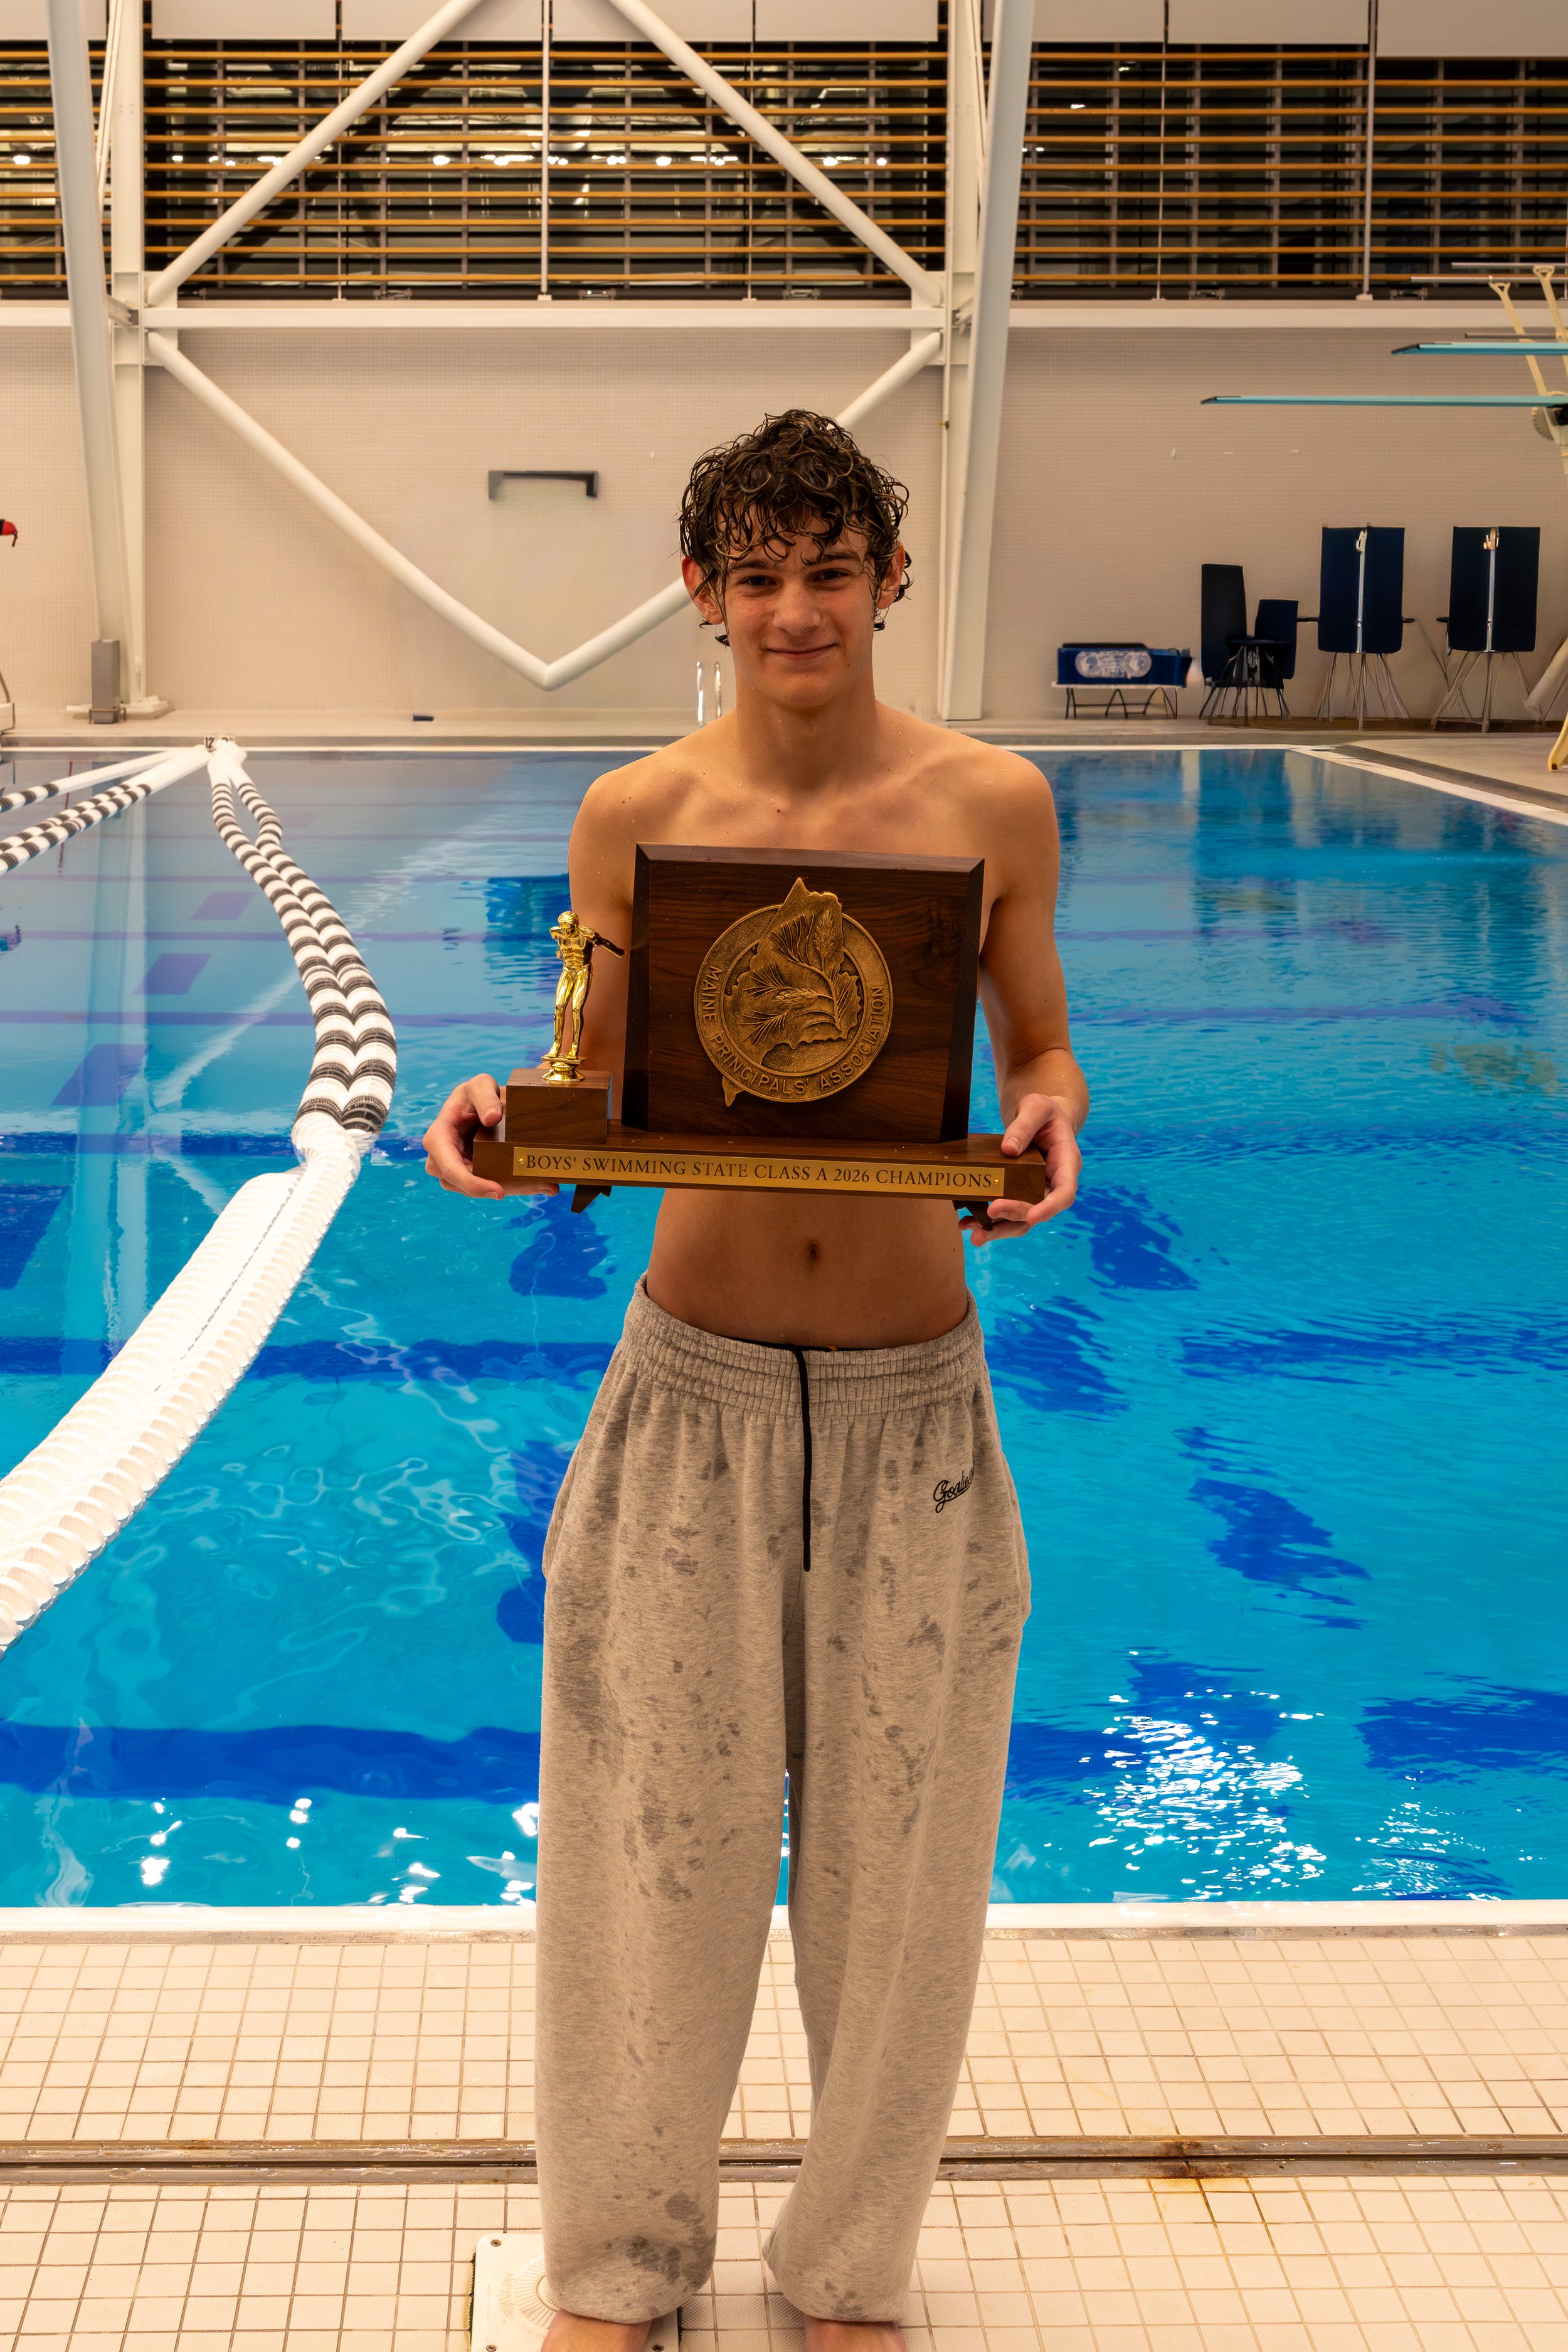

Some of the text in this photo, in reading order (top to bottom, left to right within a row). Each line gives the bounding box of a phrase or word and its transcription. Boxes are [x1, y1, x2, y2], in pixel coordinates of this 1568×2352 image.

[702, 965, 885, 1094] MAINE PRINCIPALS' ASSOCIATION
[526, 1155, 992, 1189] BOYS' SWIMMING STATE CLASS A 2026 CHAMPIONS
